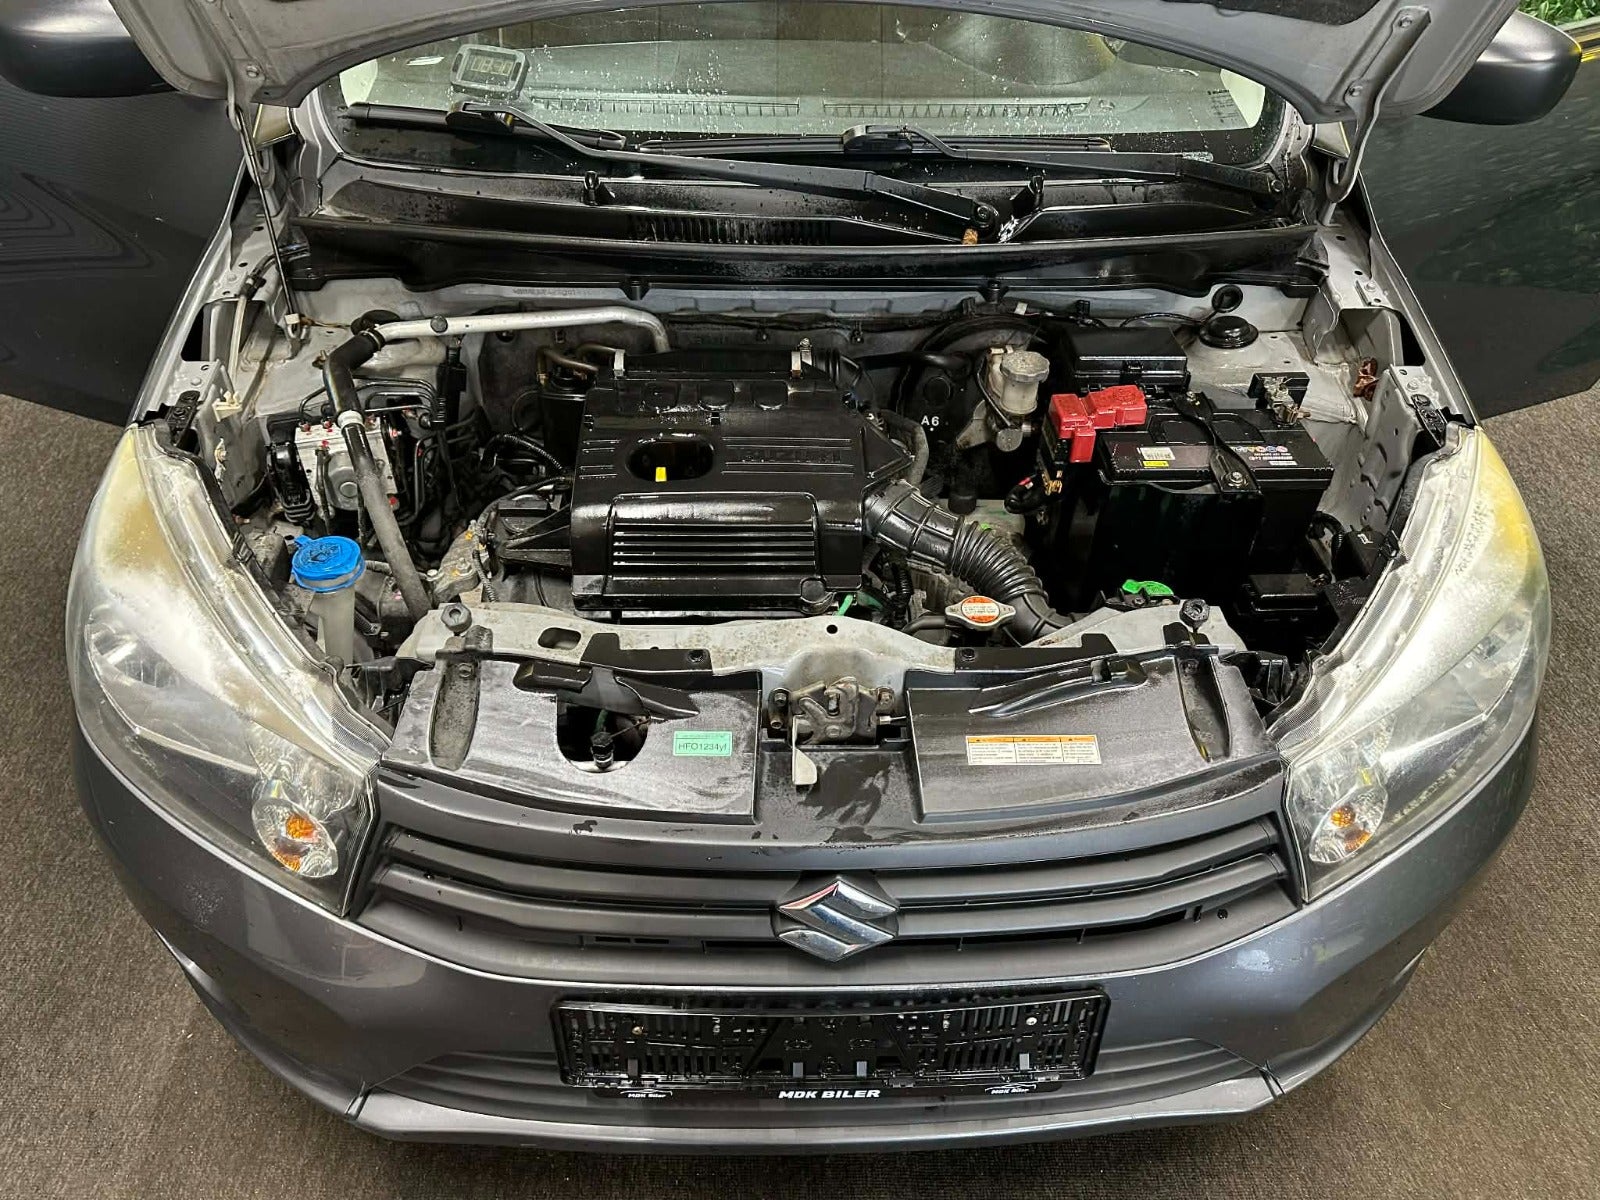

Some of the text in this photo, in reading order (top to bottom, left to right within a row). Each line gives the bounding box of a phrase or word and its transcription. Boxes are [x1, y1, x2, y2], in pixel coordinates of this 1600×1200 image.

[921, 415, 940, 427] A6
[779, 1089, 881, 1099] MDK BILER
